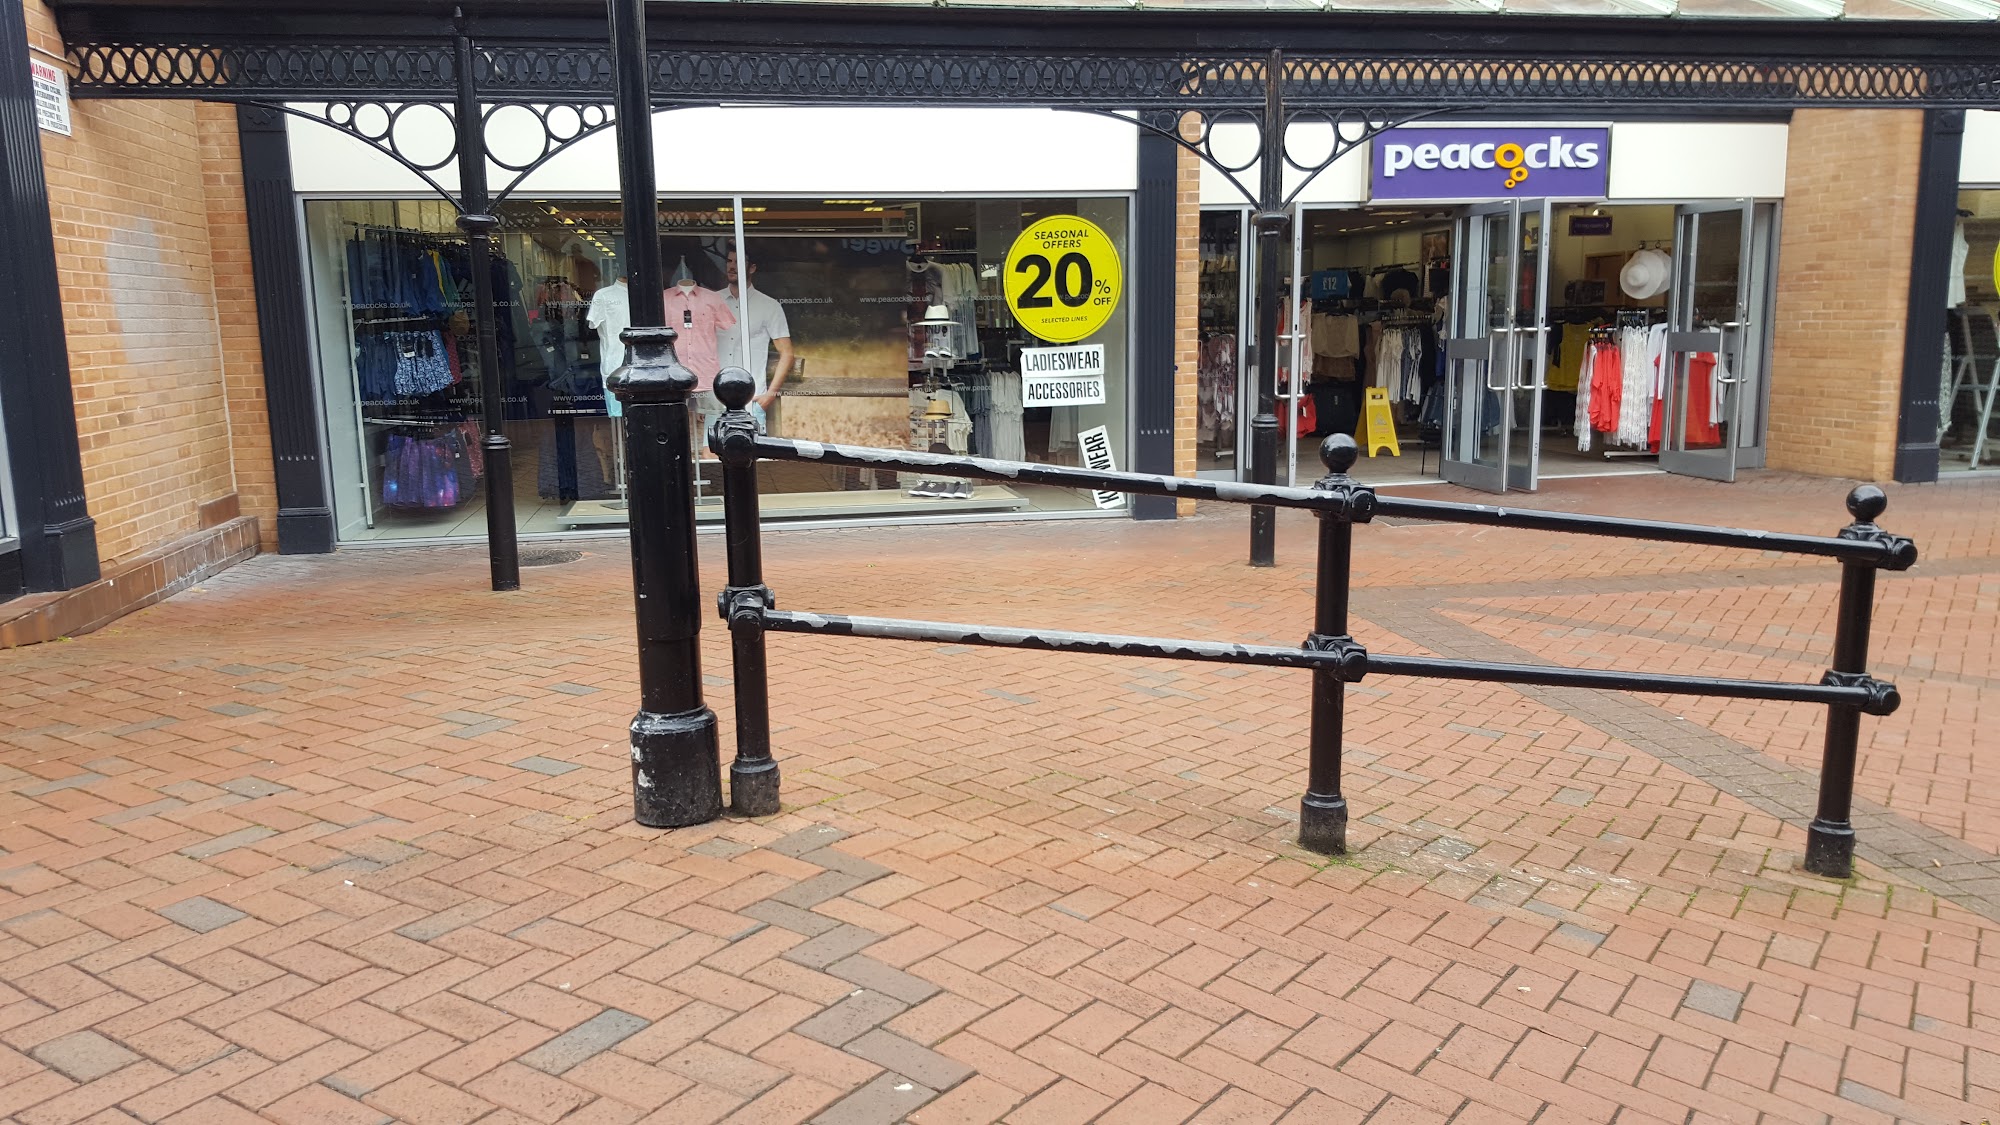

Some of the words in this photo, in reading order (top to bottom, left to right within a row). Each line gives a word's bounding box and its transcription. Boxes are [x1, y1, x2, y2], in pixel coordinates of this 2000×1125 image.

[1384, 136, 1599, 178] peacocks
[1034, 229, 1089, 240] SEASONAL
[1042, 239, 1082, 249] OFFERS
[859, 296, 931, 304] www.peacocks.co.uk
[1093, 297, 1111, 306] OFF
[1041, 316, 1070, 324] SELECTED
[1025, 351, 1100, 371] LADIESWEAR
[1028, 381, 1100, 400] ACCESSORIES
[1084, 432, 1120, 504] KWEAR
